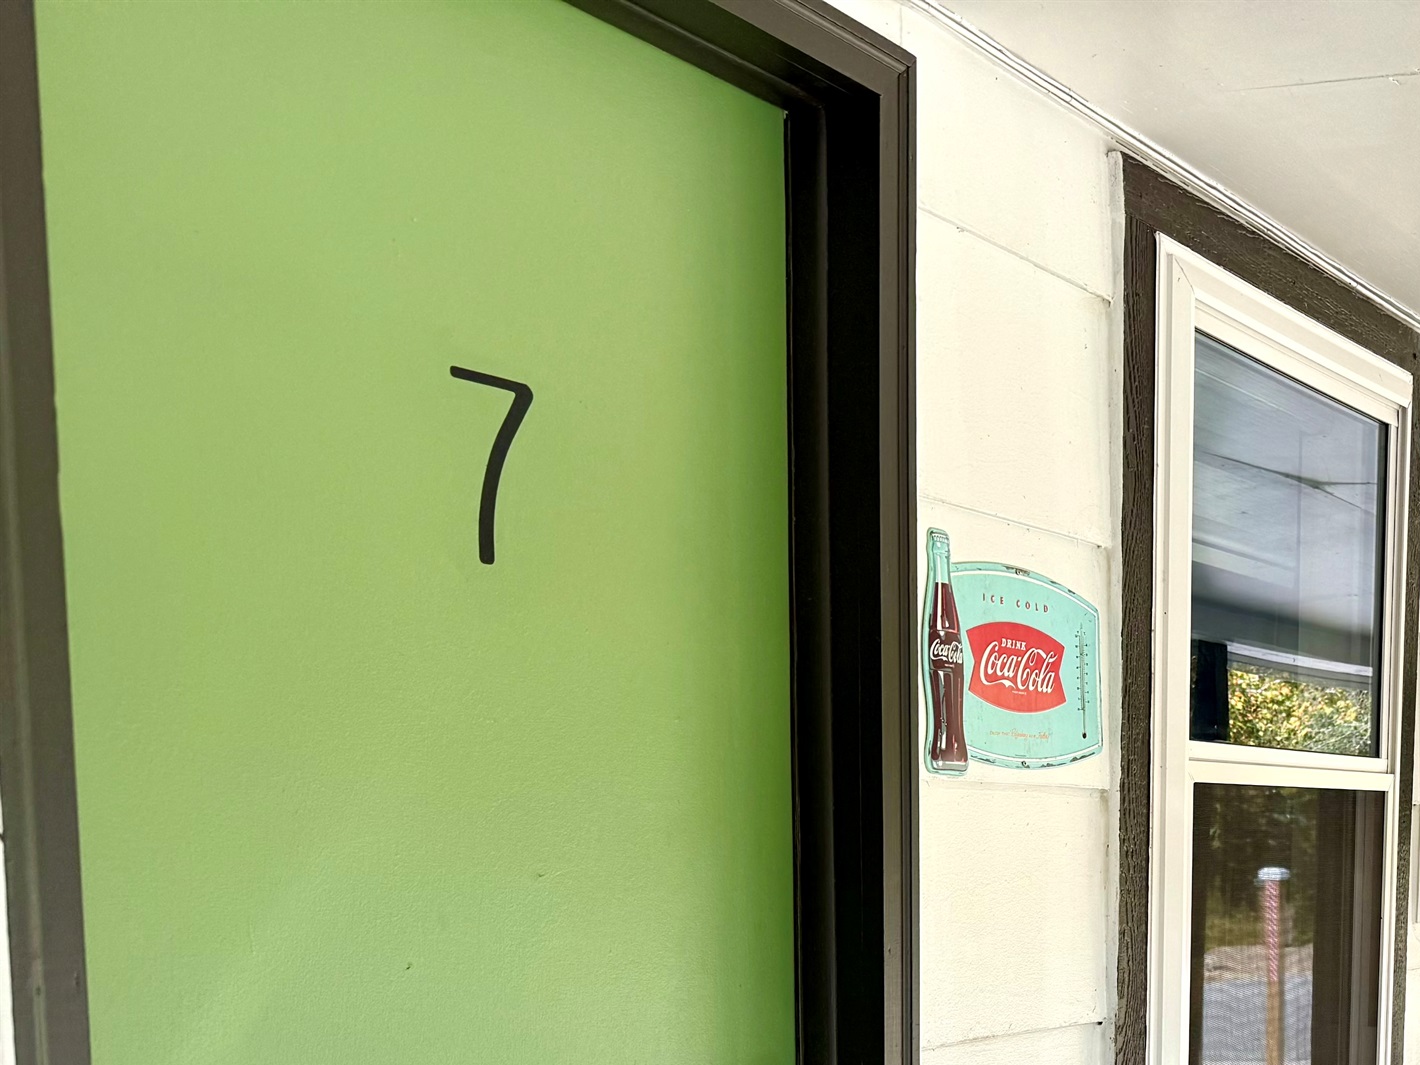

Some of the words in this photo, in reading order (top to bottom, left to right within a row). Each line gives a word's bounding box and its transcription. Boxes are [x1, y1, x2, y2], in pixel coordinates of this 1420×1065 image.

[450, 366, 533, 564] 7
[982, 593, 1004, 605] ICE
[1016, 599, 1048, 613] COLD
[1001, 638, 1027, 651] DRINK
[979, 641, 1058, 694] Coca-Cola
